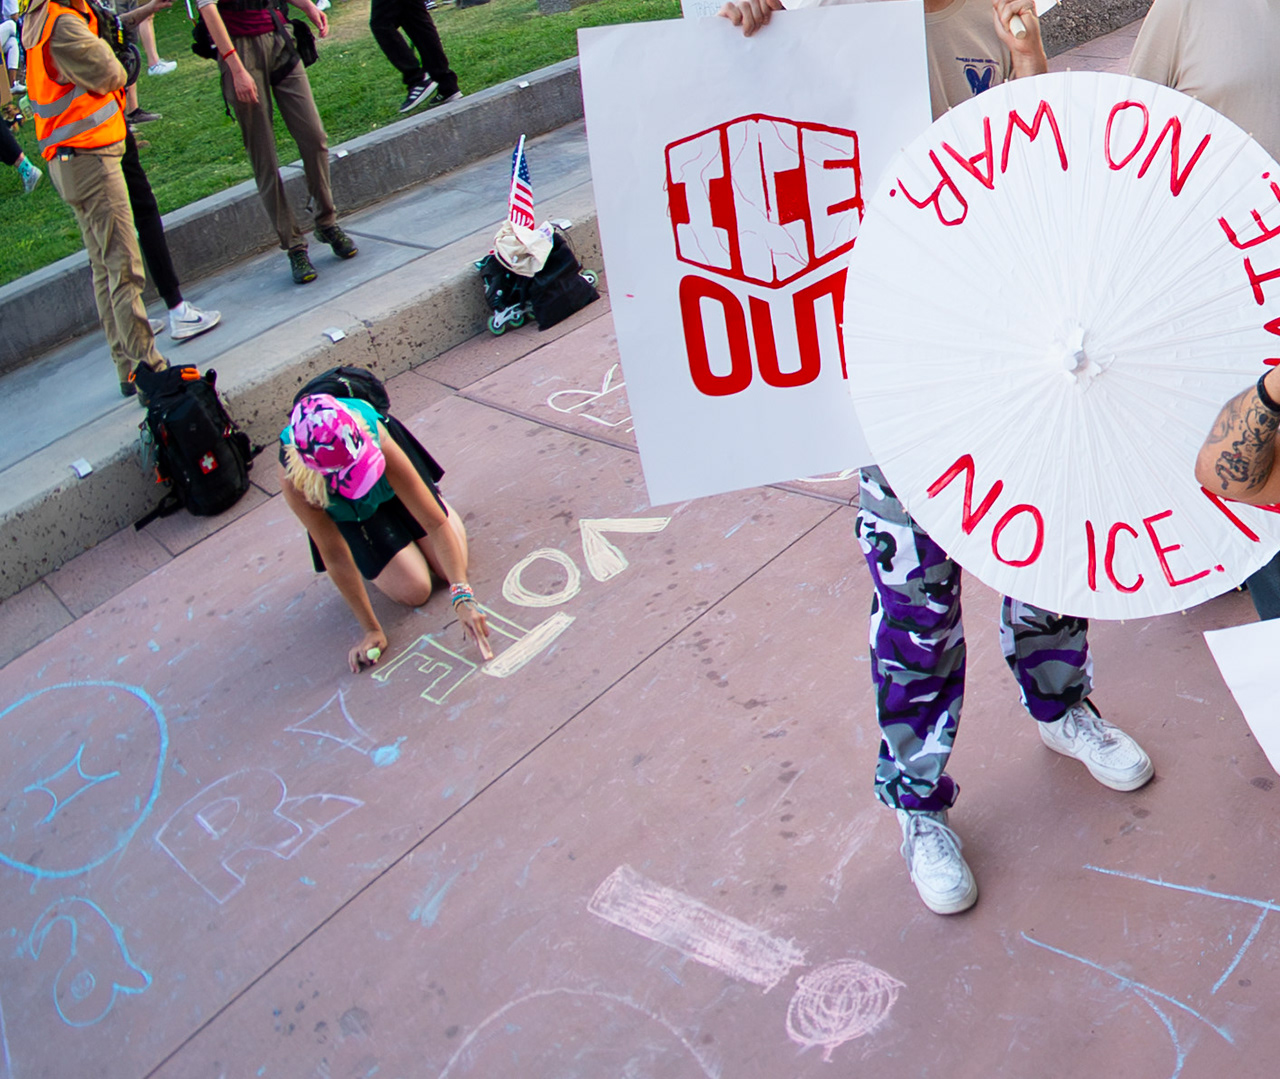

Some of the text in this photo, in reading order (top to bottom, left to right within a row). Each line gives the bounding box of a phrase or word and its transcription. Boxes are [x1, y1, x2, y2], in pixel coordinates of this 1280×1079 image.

[664, 113, 865, 290] ICE
[889, 98, 1068, 227] WAR.
[1103, 98, 1213, 198] NO
[926, 454, 1045, 568] NO
[1085, 509, 1226, 594] ICE.
